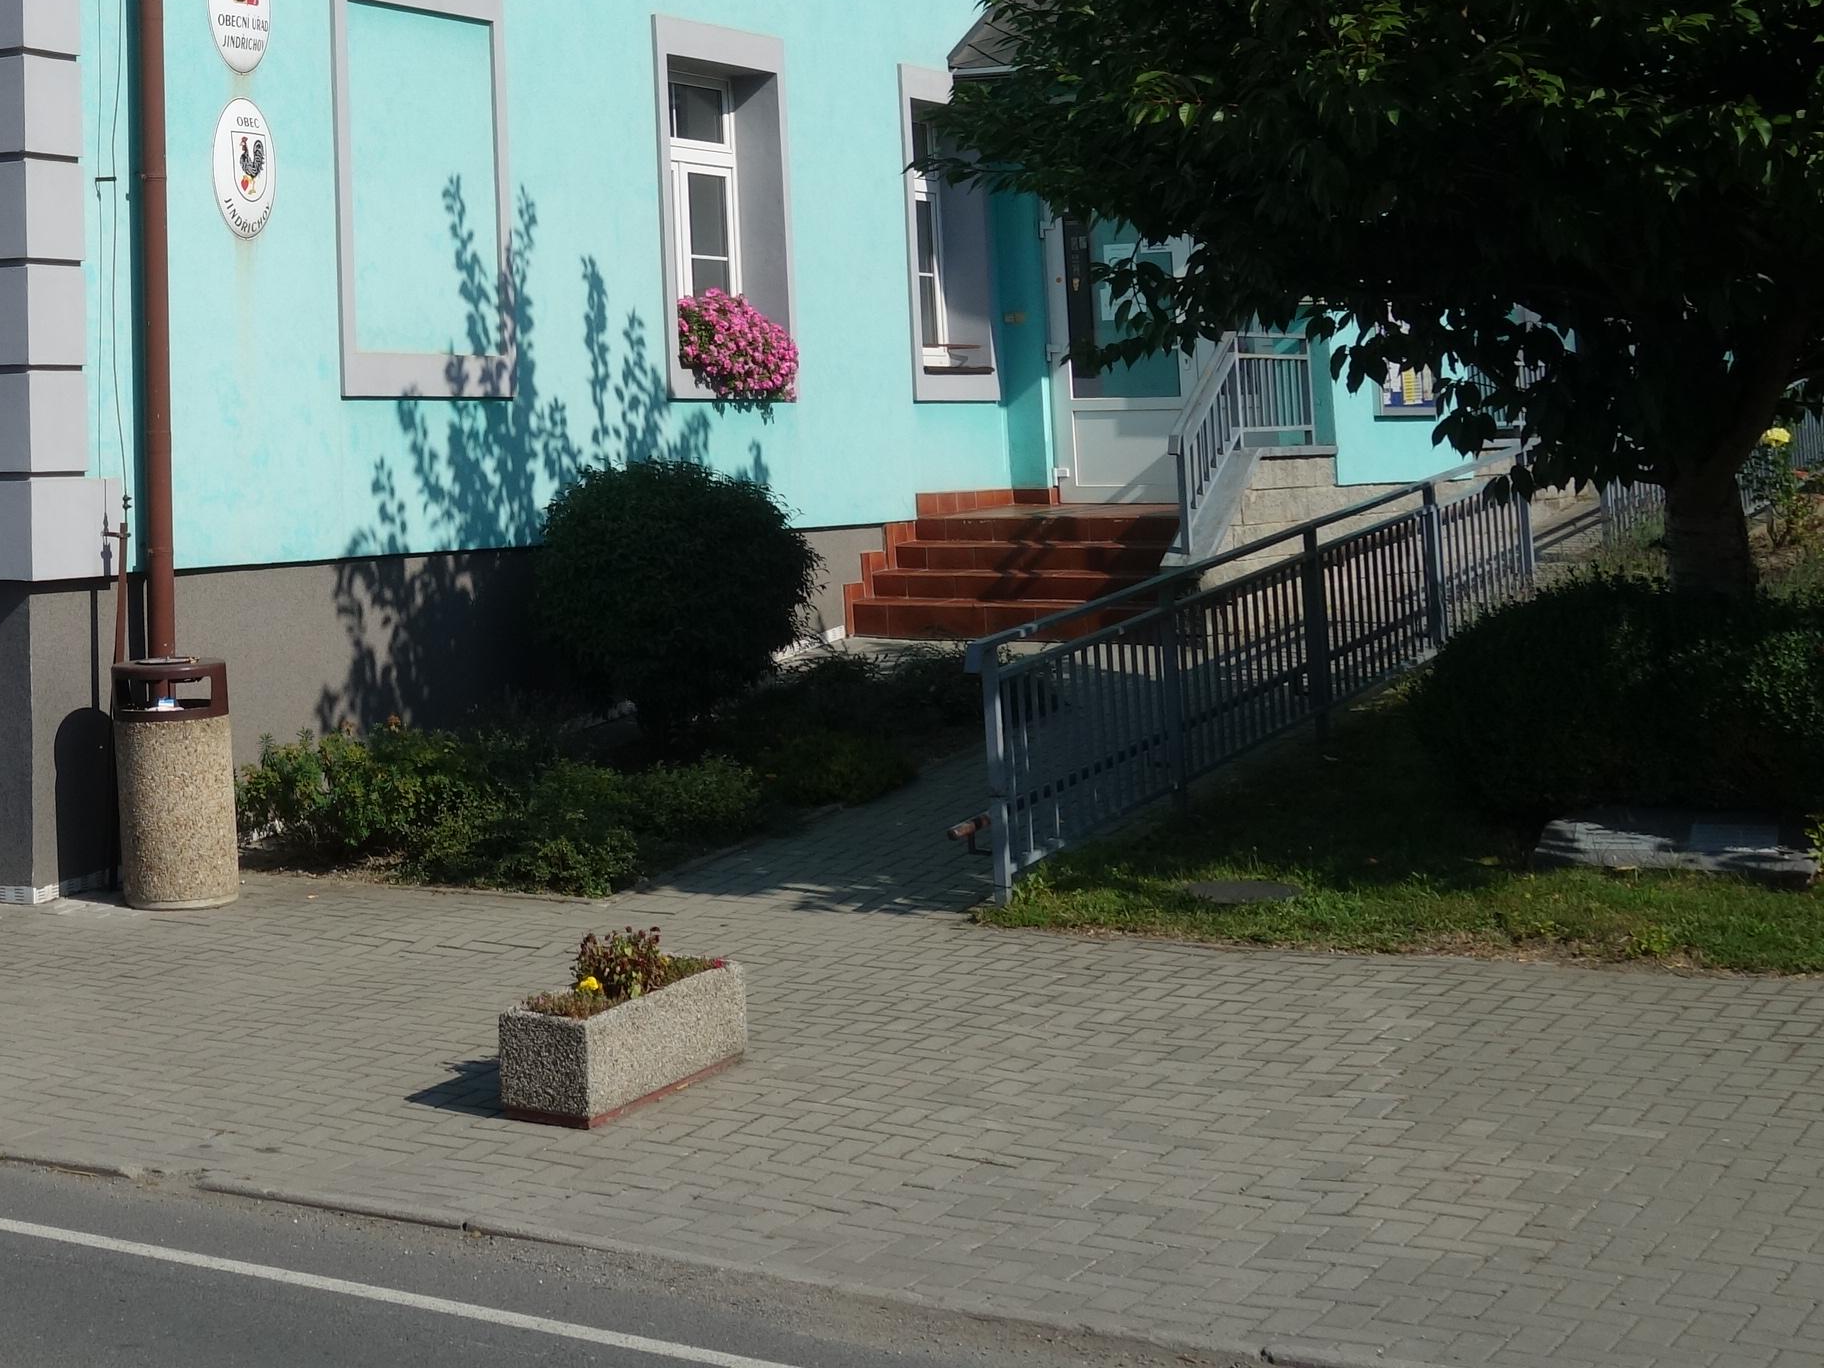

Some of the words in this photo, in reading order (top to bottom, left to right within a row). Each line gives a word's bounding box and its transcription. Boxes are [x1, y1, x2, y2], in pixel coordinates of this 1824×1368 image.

[218, 13, 250, 29] OBECNÍ
[222, 33, 264, 52] JINDŘICHOV
[236, 116, 260, 129] OBEC
